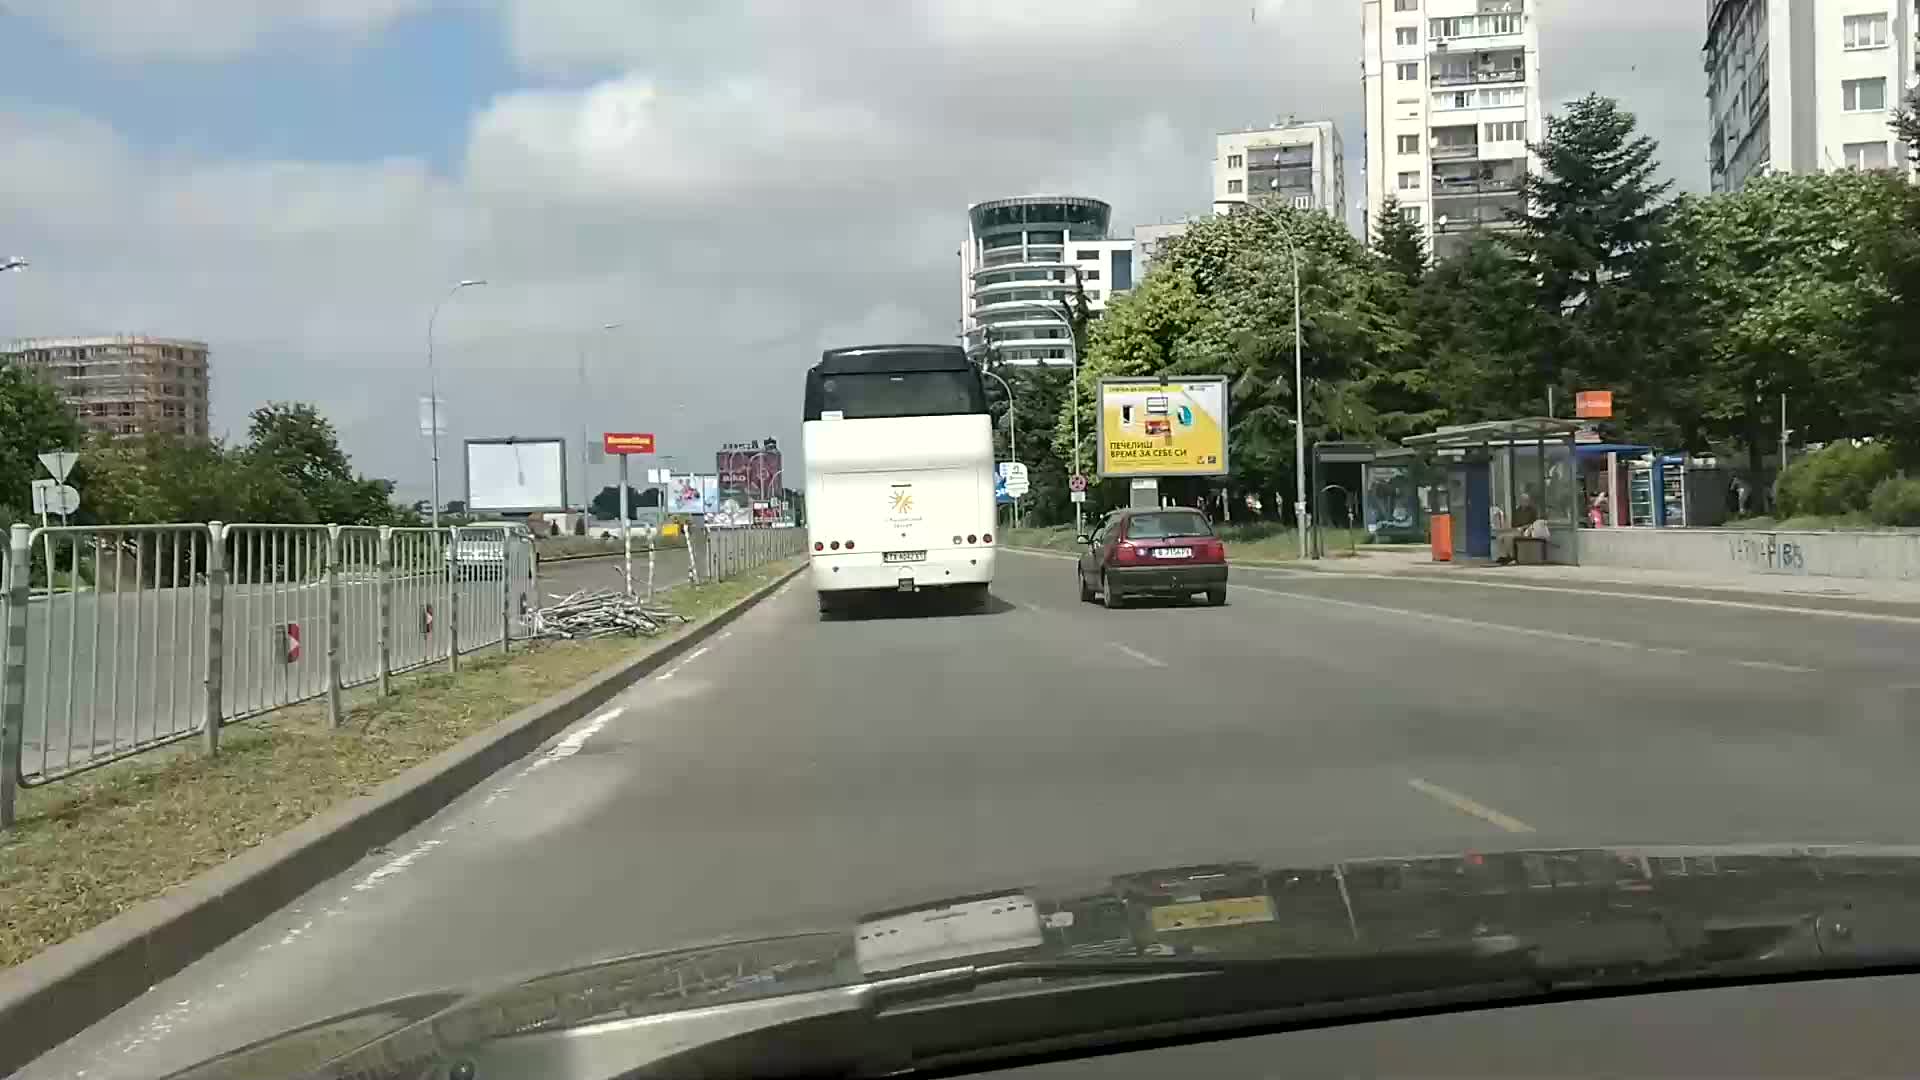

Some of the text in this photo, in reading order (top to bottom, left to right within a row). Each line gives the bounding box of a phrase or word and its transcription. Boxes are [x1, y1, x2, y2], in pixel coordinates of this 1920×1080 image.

[1110, 441, 1153, 449] ПЕЧЕЛИШ
[1110, 450, 1137, 458] ВРЕМЕ
[1153, 449, 1173, 457] СЕБЕ
